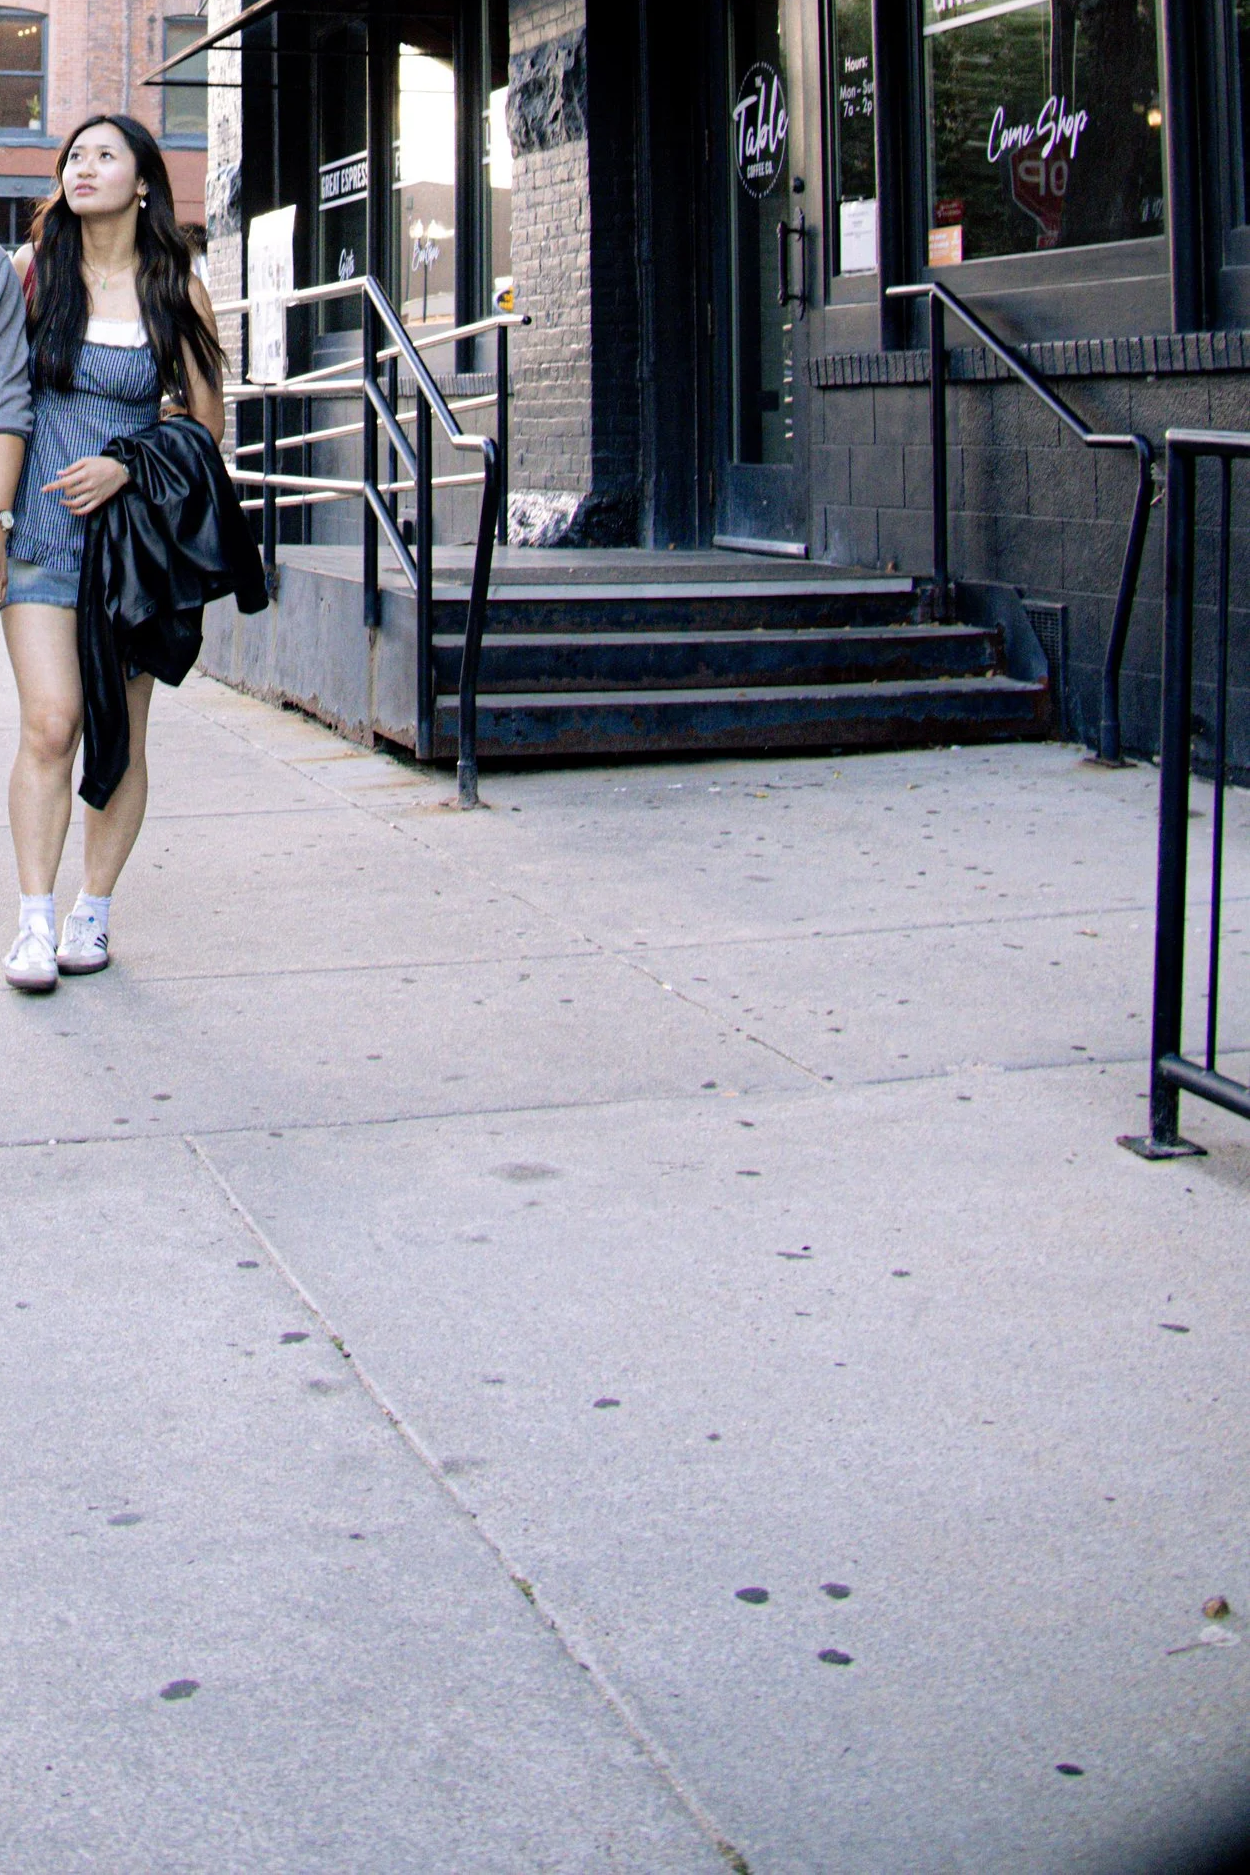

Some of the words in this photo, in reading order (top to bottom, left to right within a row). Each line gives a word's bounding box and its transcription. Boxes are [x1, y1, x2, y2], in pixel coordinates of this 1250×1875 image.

[844, 56, 868, 73] Hours:
[840, 84, 856, 101] Mon
[732, 74, 789, 167] Table
[987, 105, 1034, 163] Come
[1036, 95, 1088, 159] Shop
[747, 161, 764, 179] COFFEE
[321, 170, 340, 199] GREAT
